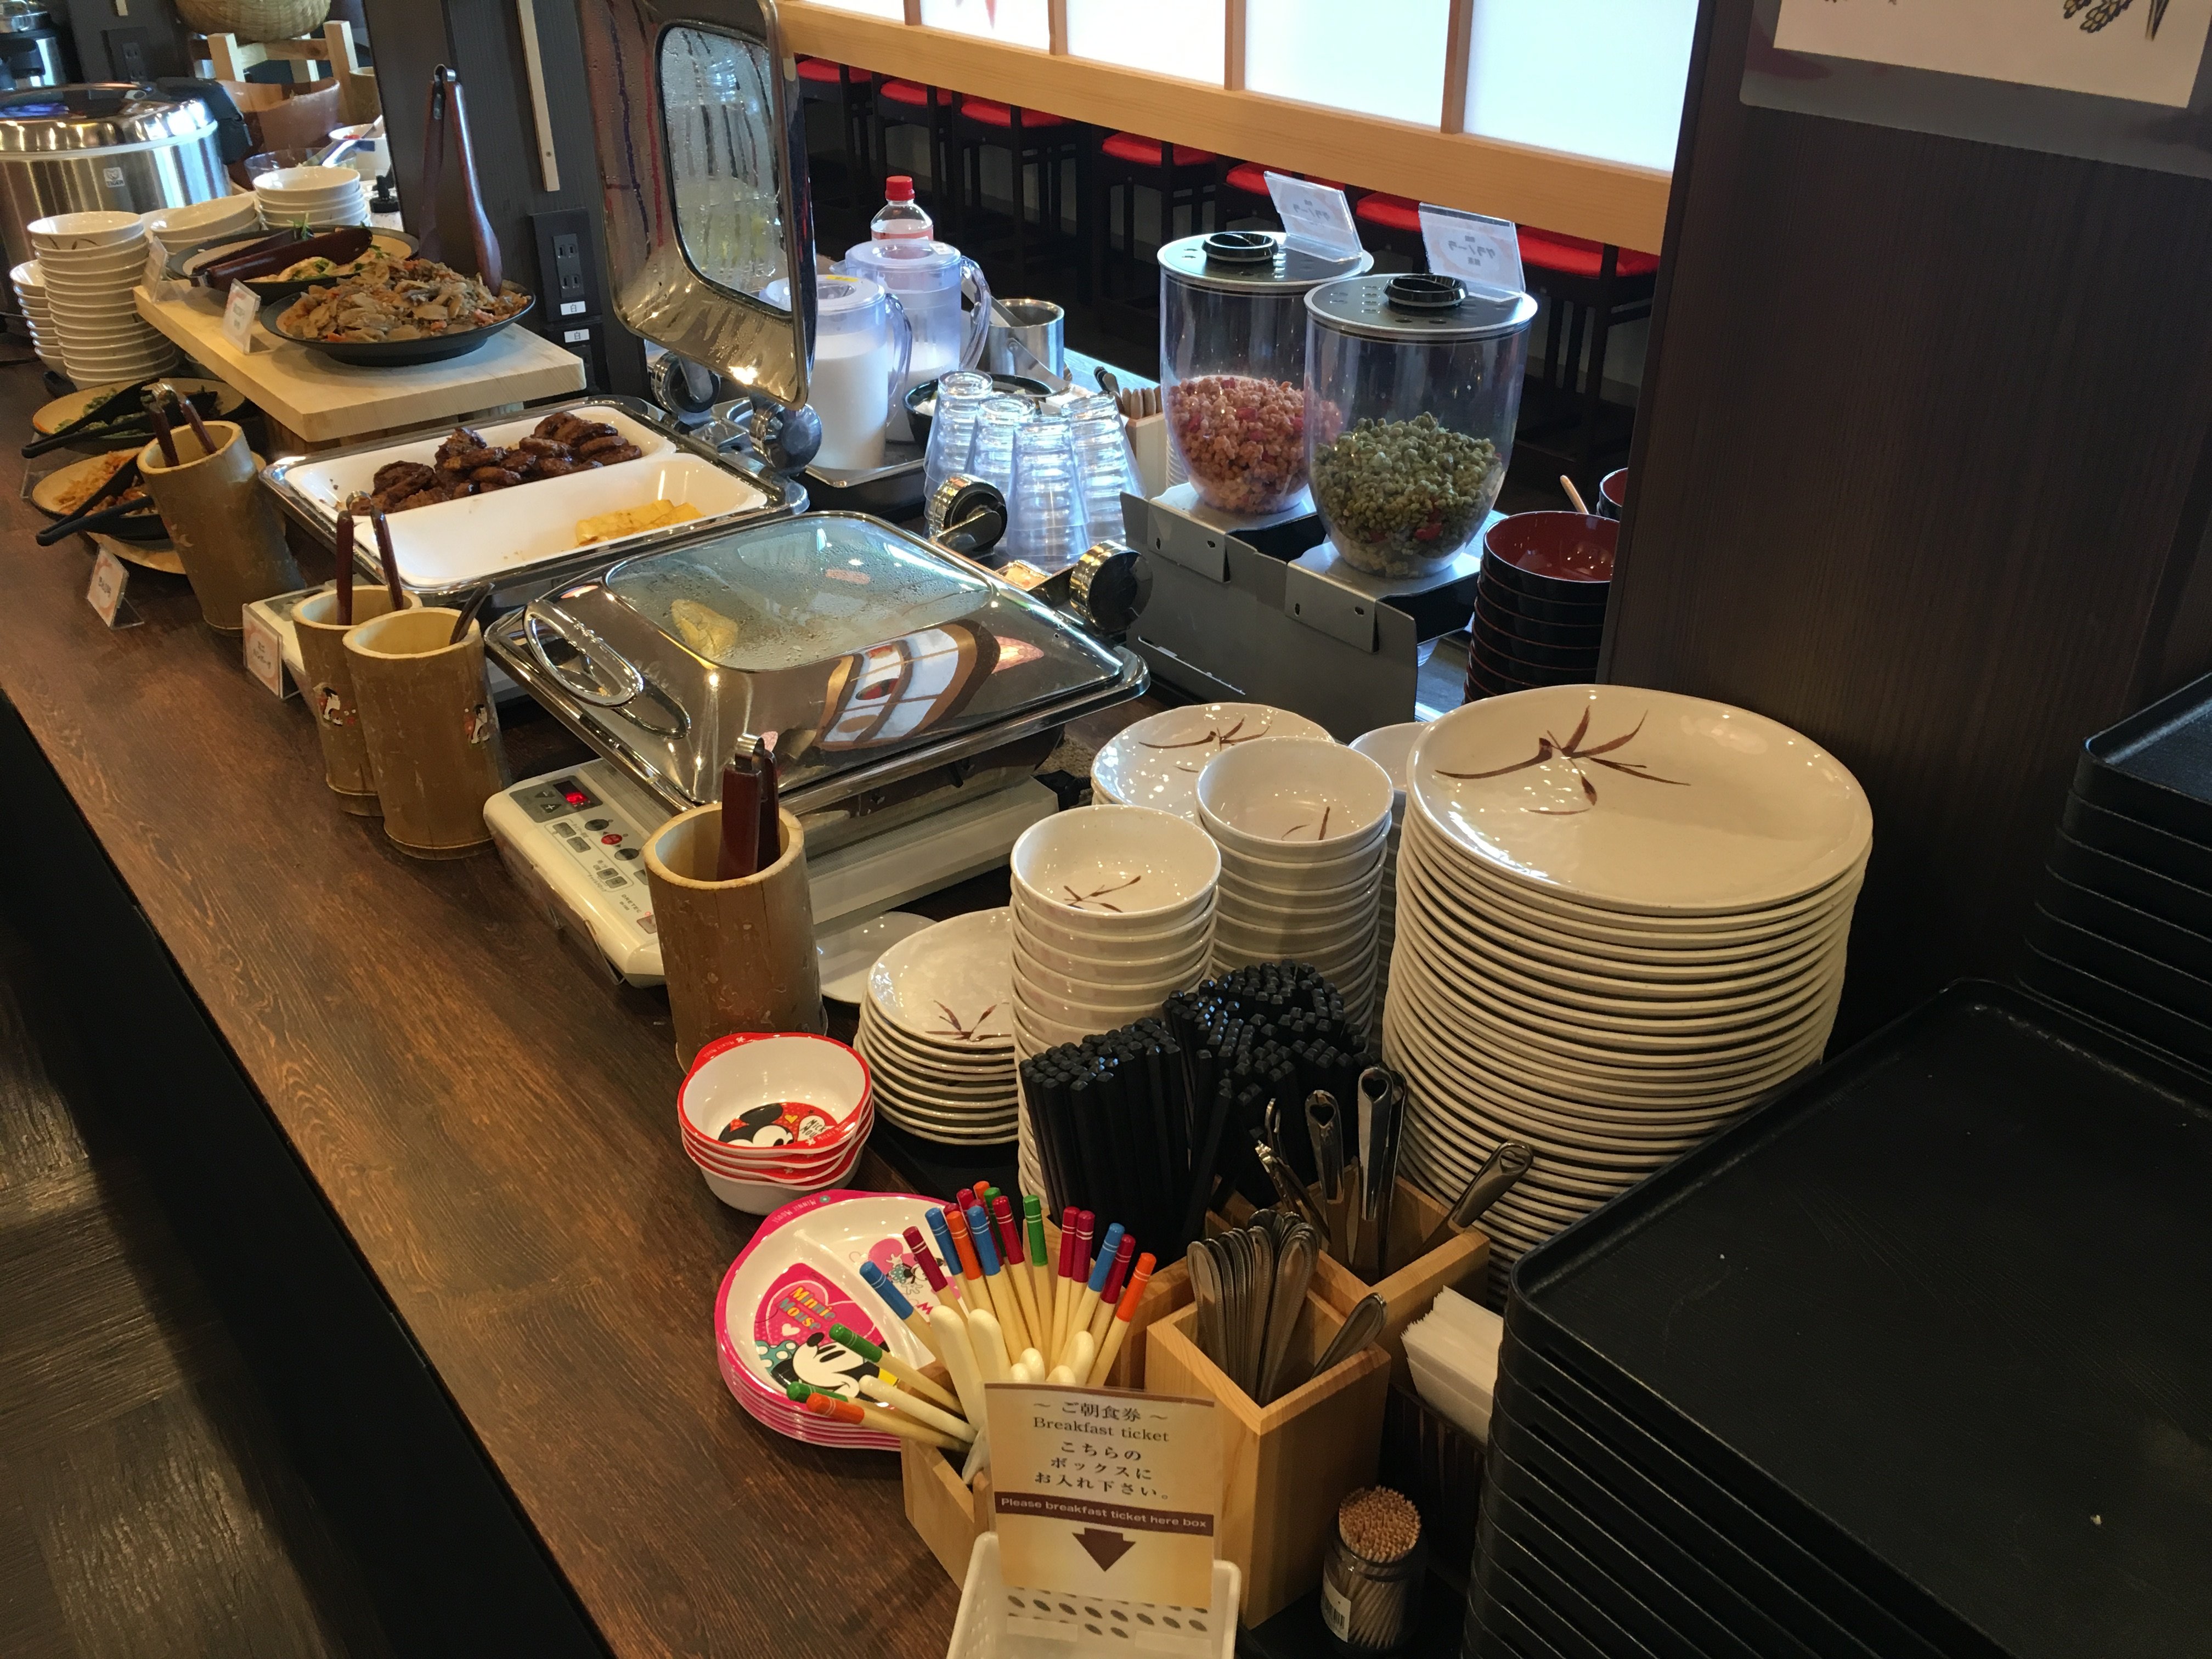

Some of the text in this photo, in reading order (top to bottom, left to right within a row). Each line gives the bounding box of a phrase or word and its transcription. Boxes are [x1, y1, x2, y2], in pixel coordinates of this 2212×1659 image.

[778, 1297, 821, 1330] Mouse
[790, 1286, 836, 1321] Minnie
[1033, 1417, 1170, 1443] Breakfast ticket
[1060, 1441, 1142, 1461] こちらの
[1051, 1457, 1152, 1480] ボックスに
[1001, 1497, 1207, 1528] Please breakfast ticket here box
